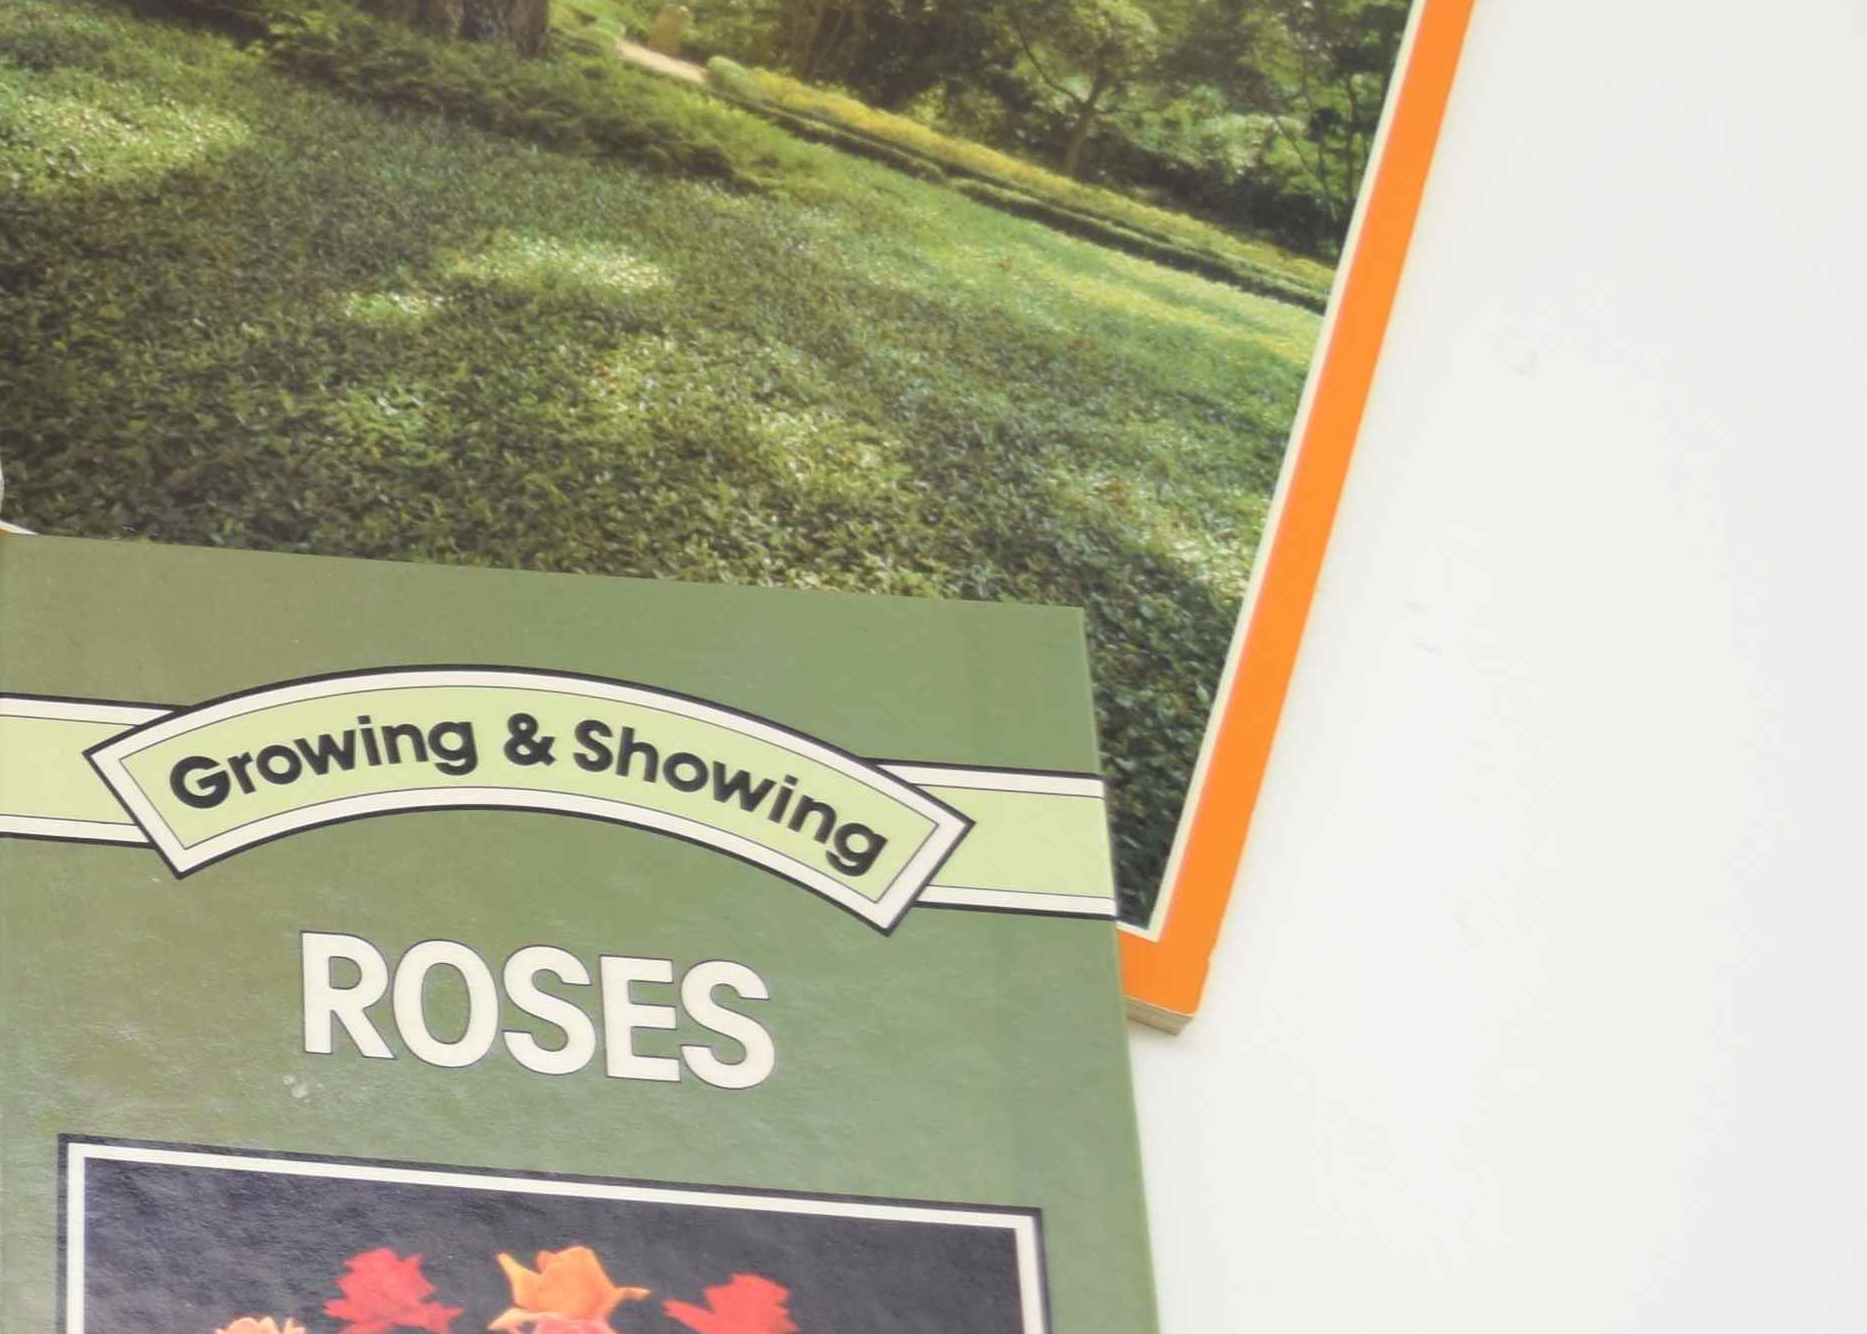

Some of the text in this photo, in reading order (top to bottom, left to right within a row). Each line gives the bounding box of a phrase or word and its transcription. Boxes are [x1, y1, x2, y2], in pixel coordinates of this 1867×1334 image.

[168, 711, 890, 878] Growing & Showing
[301, 930, 777, 1091] ROSES
